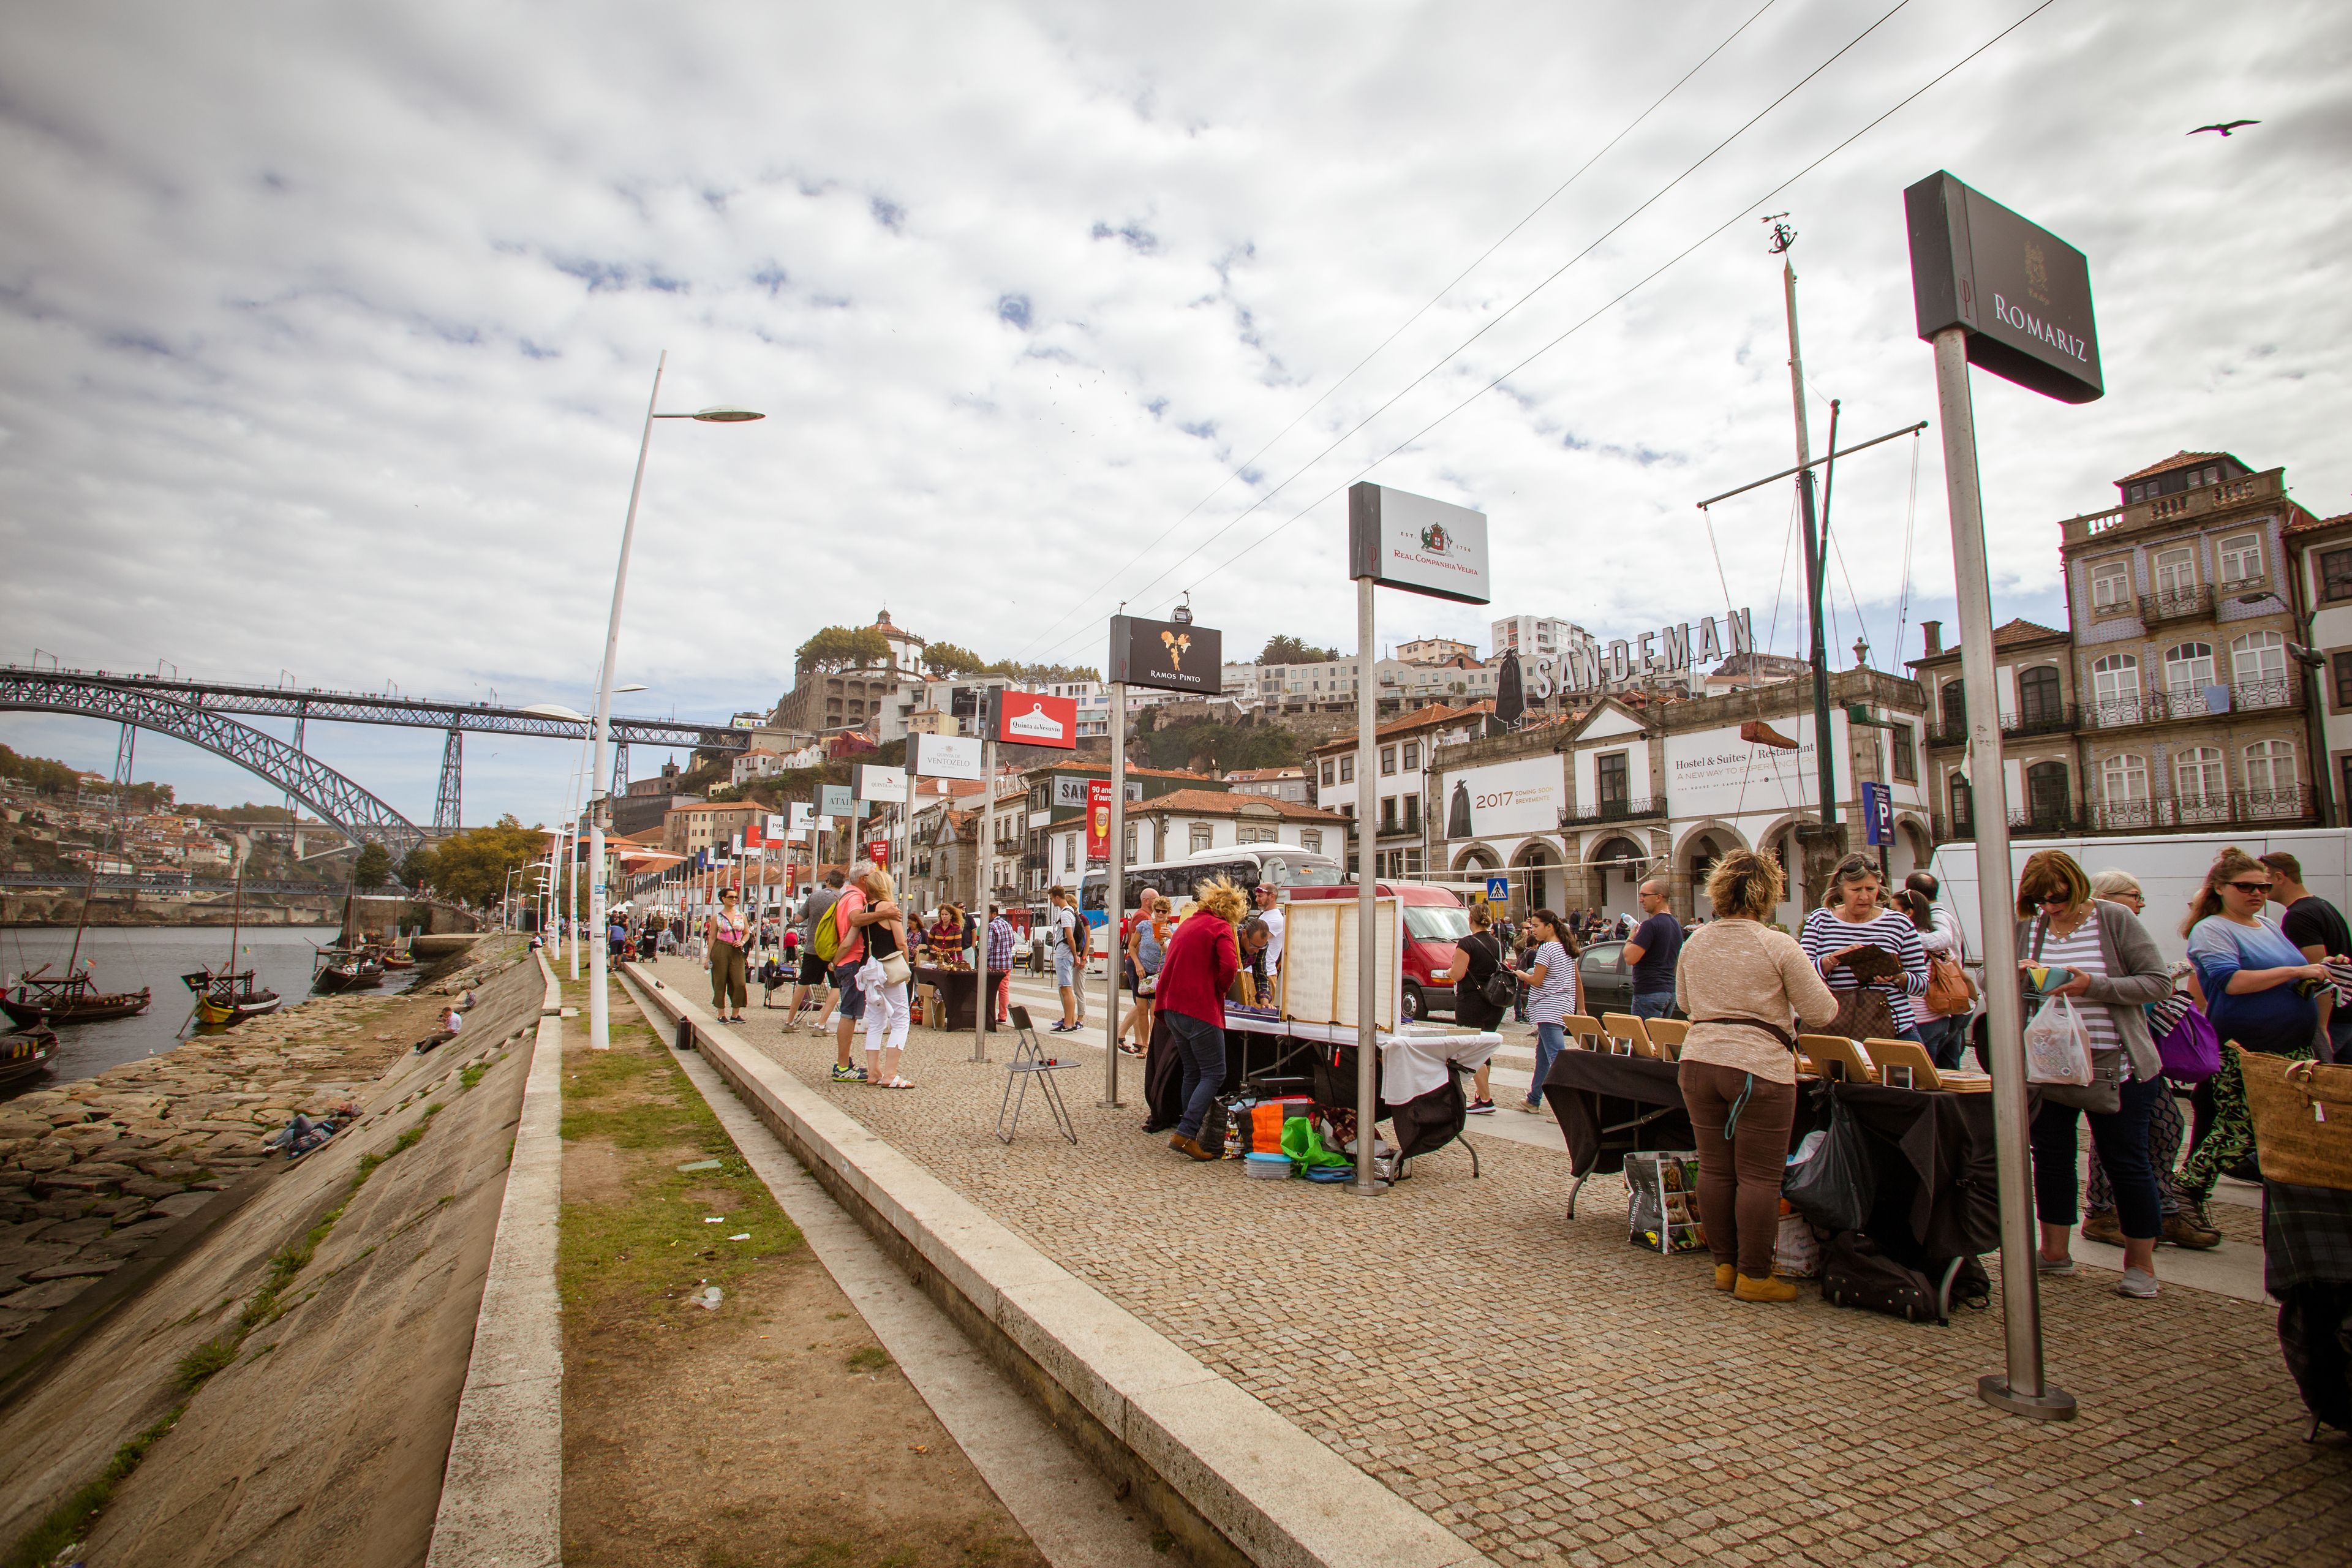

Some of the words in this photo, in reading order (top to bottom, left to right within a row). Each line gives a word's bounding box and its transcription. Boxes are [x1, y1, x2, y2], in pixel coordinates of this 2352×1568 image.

[1994, 293, 2087, 363] ROMARIZ
[1394, 549, 1414, 561] REAL
[1415, 554, 1457, 570] COMPANHIA
[1457, 563, 1479, 576] VELHA
[1535, 607, 1752, 699] SANDEMAN
[1150, 670, 1177, 679] RAMOS
[1180, 673, 1200, 683] PINTO
[1039, 723, 1060, 732] Vesuvio
[927, 756, 970, 767] VENTOZELO
[1675, 757, 1705, 769] Hostel
[1706, 756, 1715, 766] &
[1717, 753, 1746, 764] Suites
[1758, 743, 1815, 759] Restaurant
[1740, 759, 1799, 773] EXPERIENCE
[1515, 787, 1536, 796] COMING
[1515, 795, 1550, 804] BREVEMENTE
[1476, 791, 1513, 809] 2017
[1879, 802, 1889, 826] P
